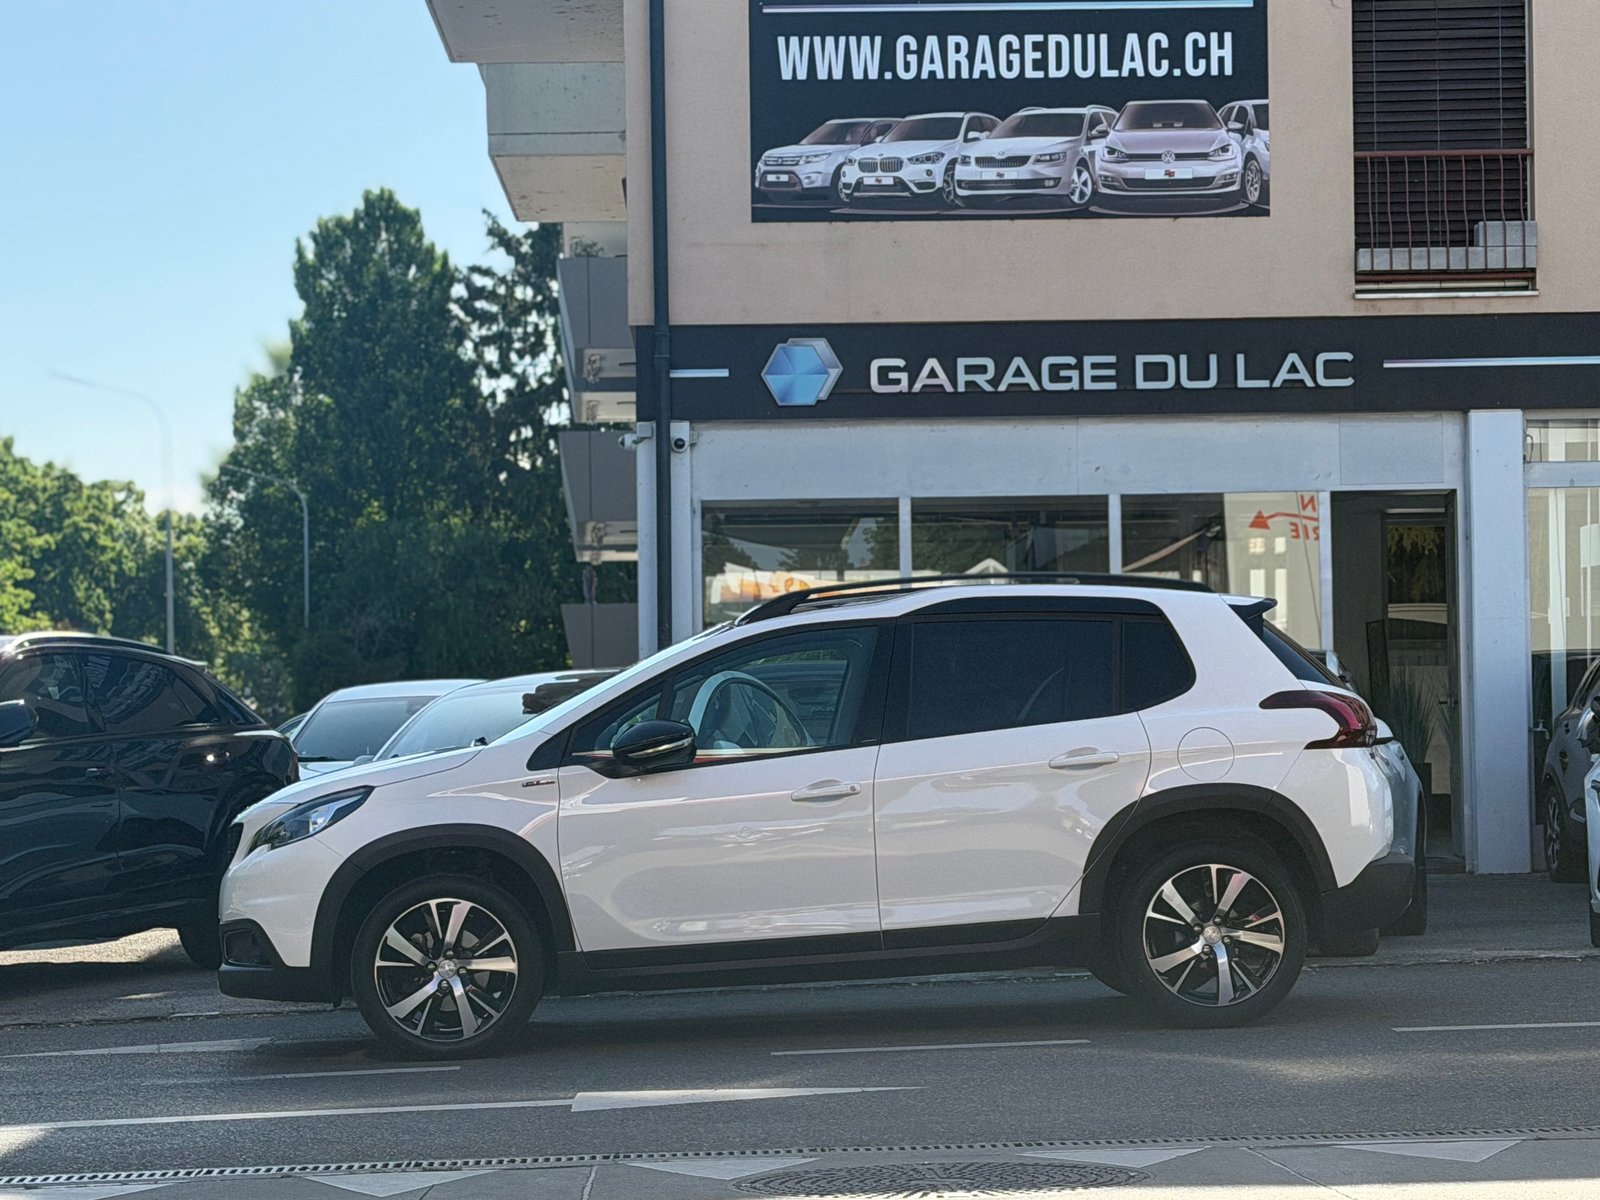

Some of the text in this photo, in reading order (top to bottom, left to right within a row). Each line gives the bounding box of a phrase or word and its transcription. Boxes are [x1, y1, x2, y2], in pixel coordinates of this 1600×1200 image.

[777, 31, 1233, 81] WWW.GARAGEDULAC.CH
[869, 351, 1355, 393] GARAGE DU LAC
